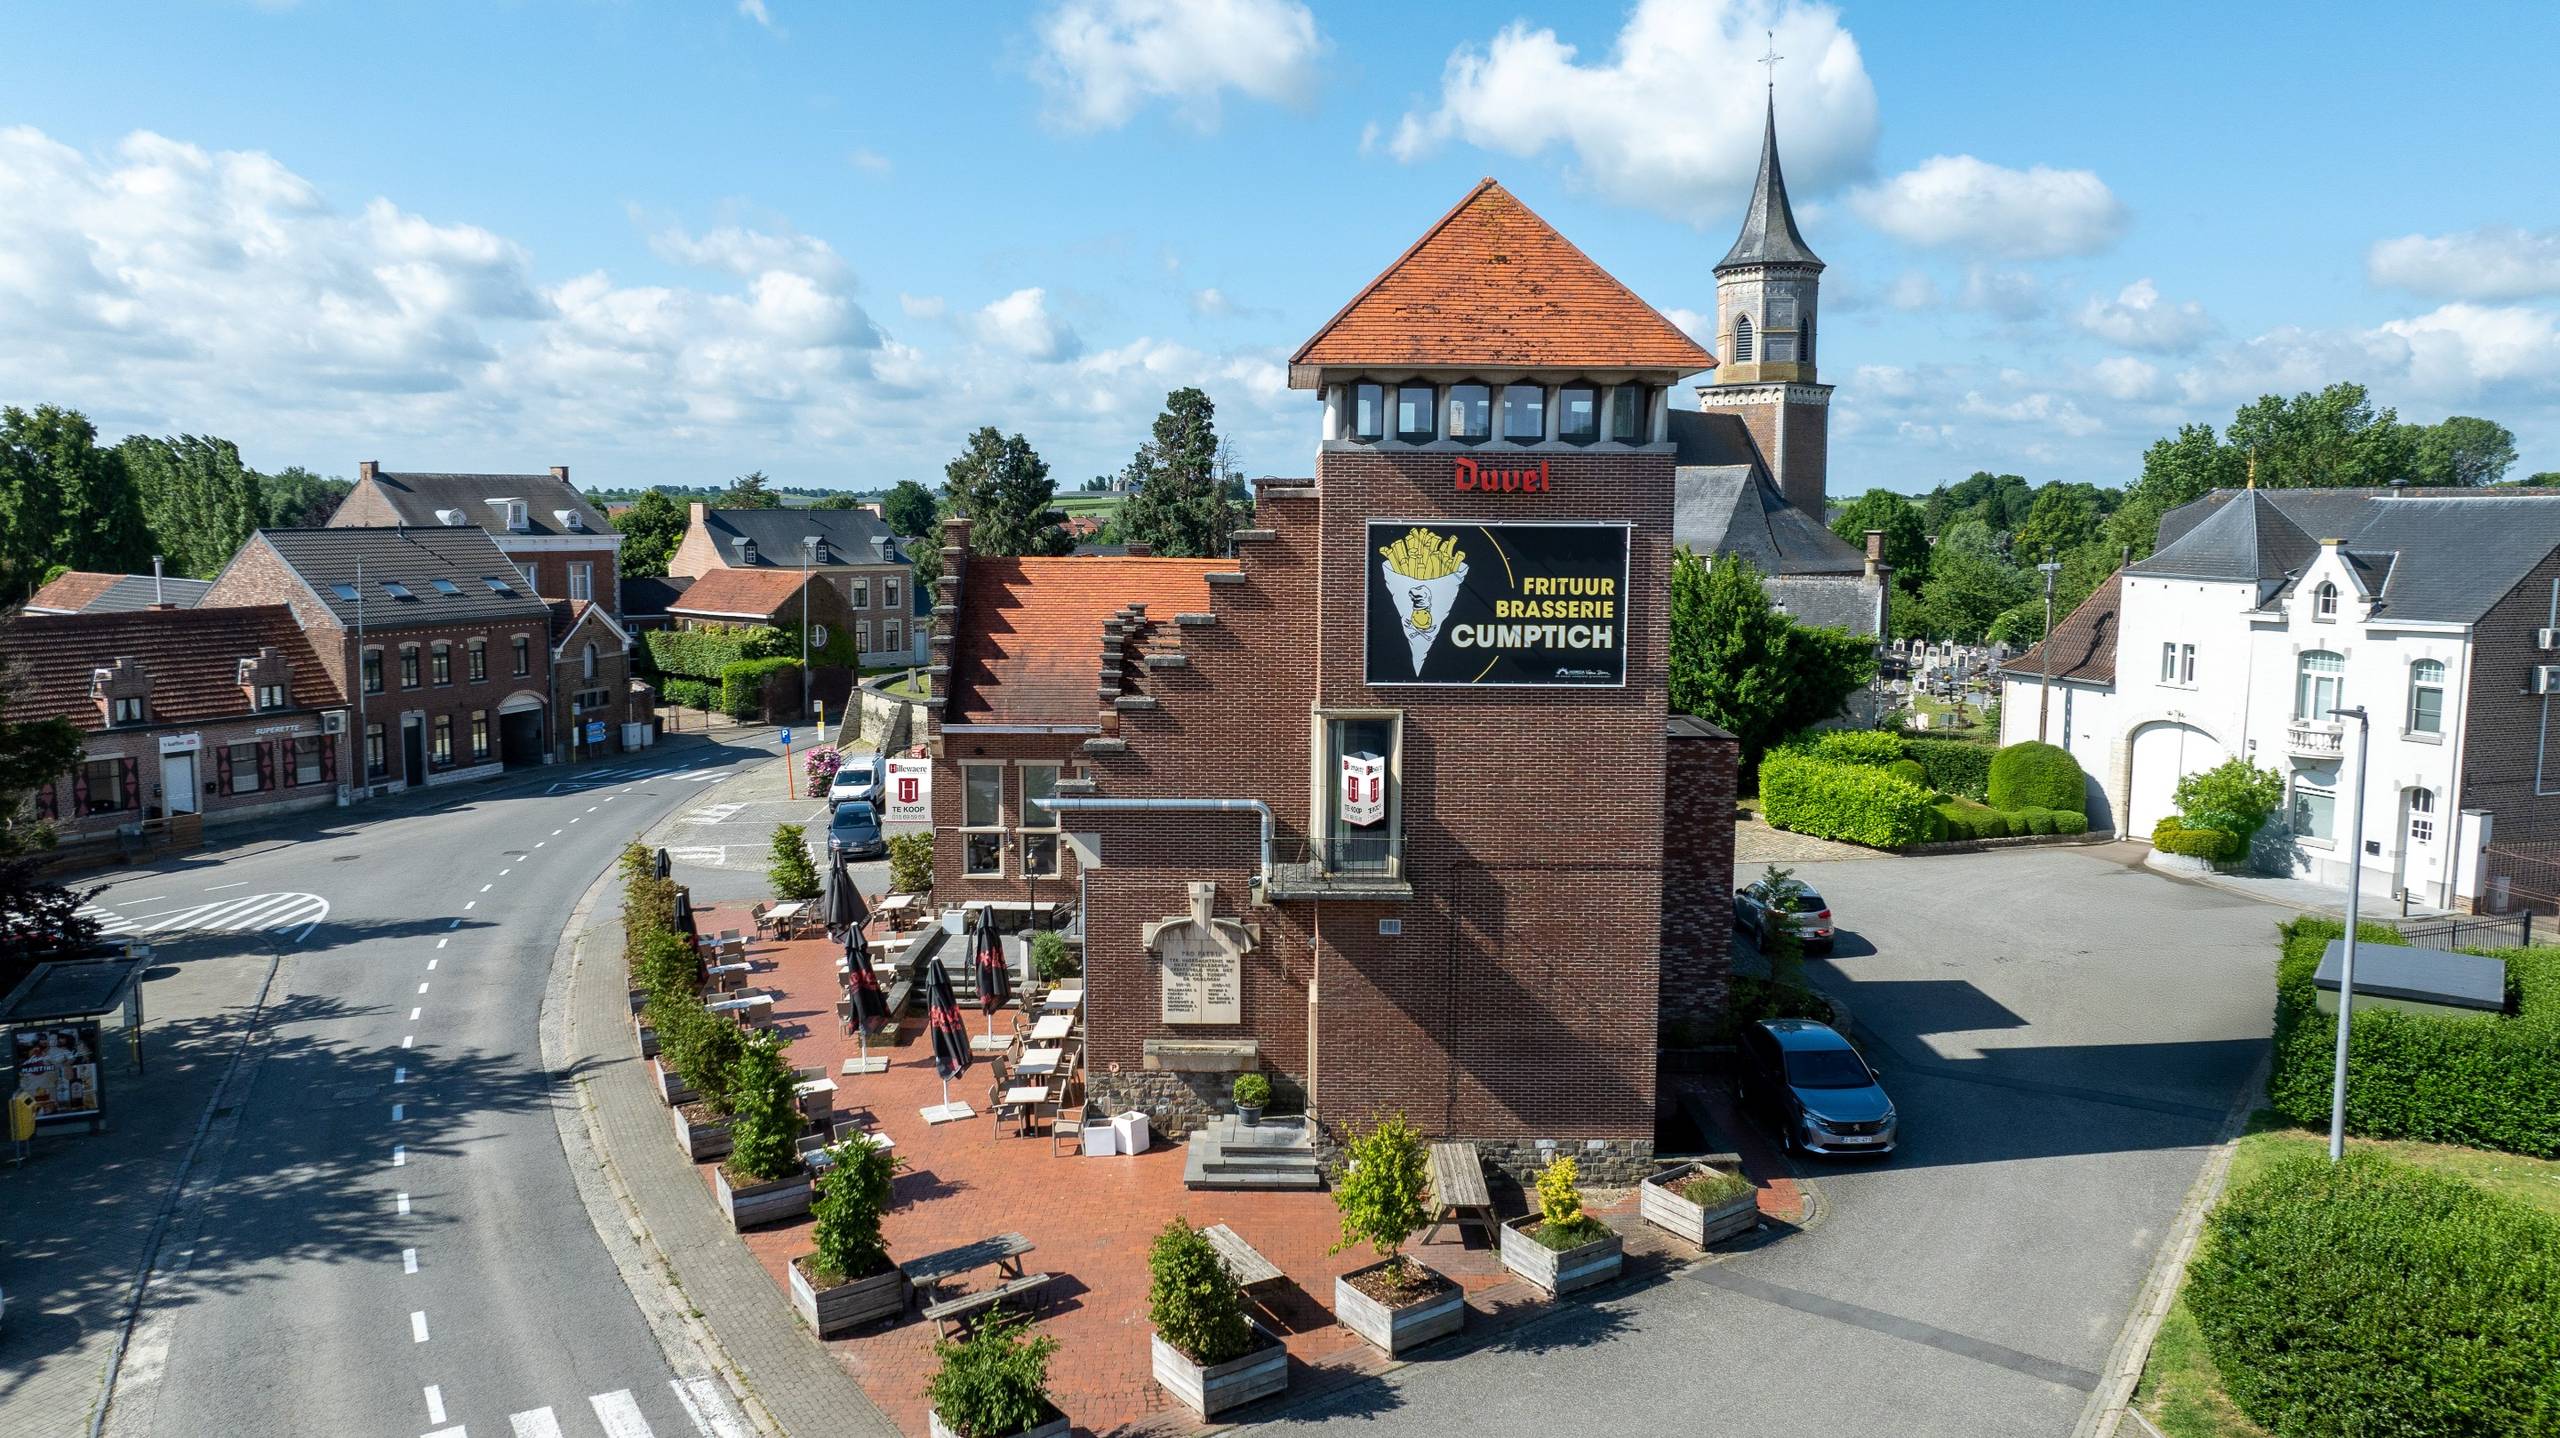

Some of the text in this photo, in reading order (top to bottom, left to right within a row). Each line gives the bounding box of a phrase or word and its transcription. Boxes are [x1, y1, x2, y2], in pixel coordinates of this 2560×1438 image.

[1455, 457, 1549, 492] Duvel
[1523, 577, 1615, 596] FRITUUR
[1495, 600, 1614, 619] BRASSERIE
[1450, 624, 1613, 649] CUMPTICH
[255, 725, 301, 735] SUPERETTE
[889, 764, 927, 773] Hillewaere
